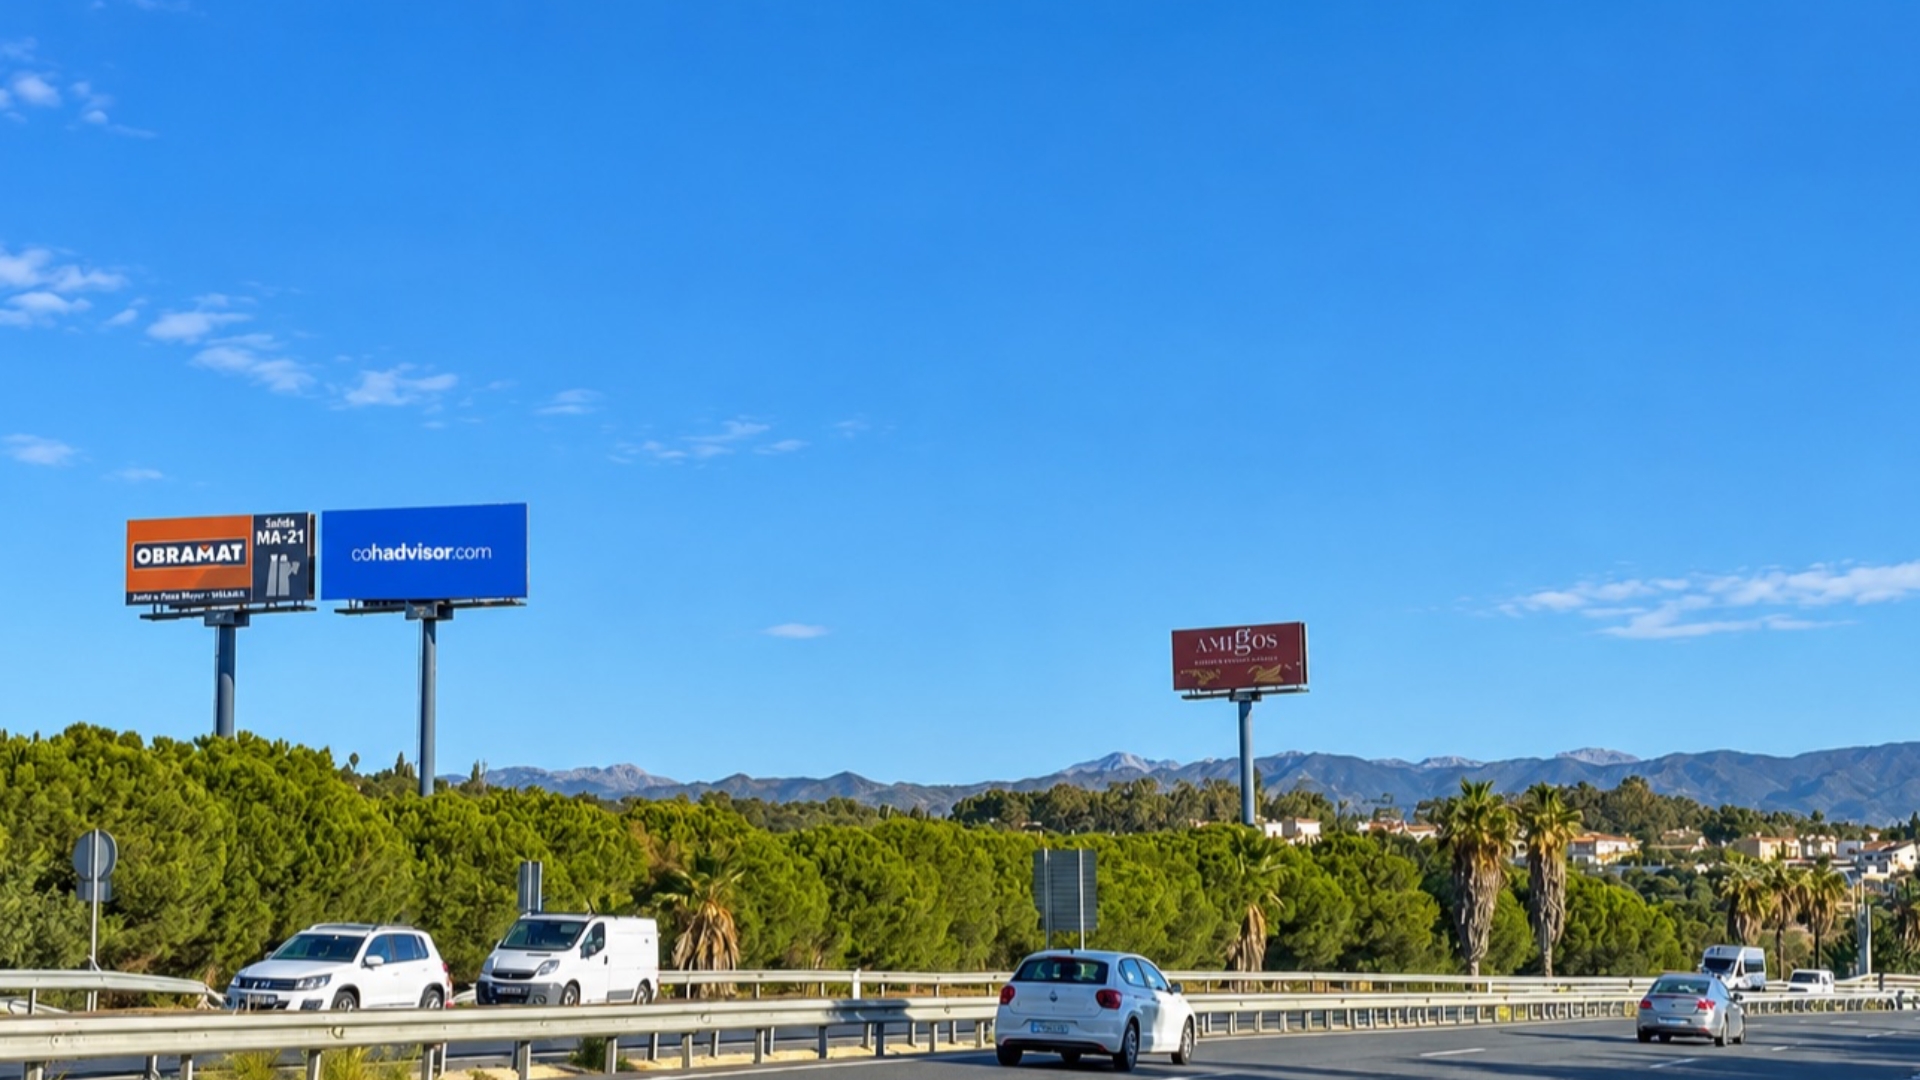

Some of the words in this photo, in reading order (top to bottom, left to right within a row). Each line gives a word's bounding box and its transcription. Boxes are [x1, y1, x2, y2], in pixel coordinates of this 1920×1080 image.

[256, 529, 304, 546] MA-21
[136, 543, 243, 565] OBRAMAT
[351, 542, 492, 562] cohadvisor.com
